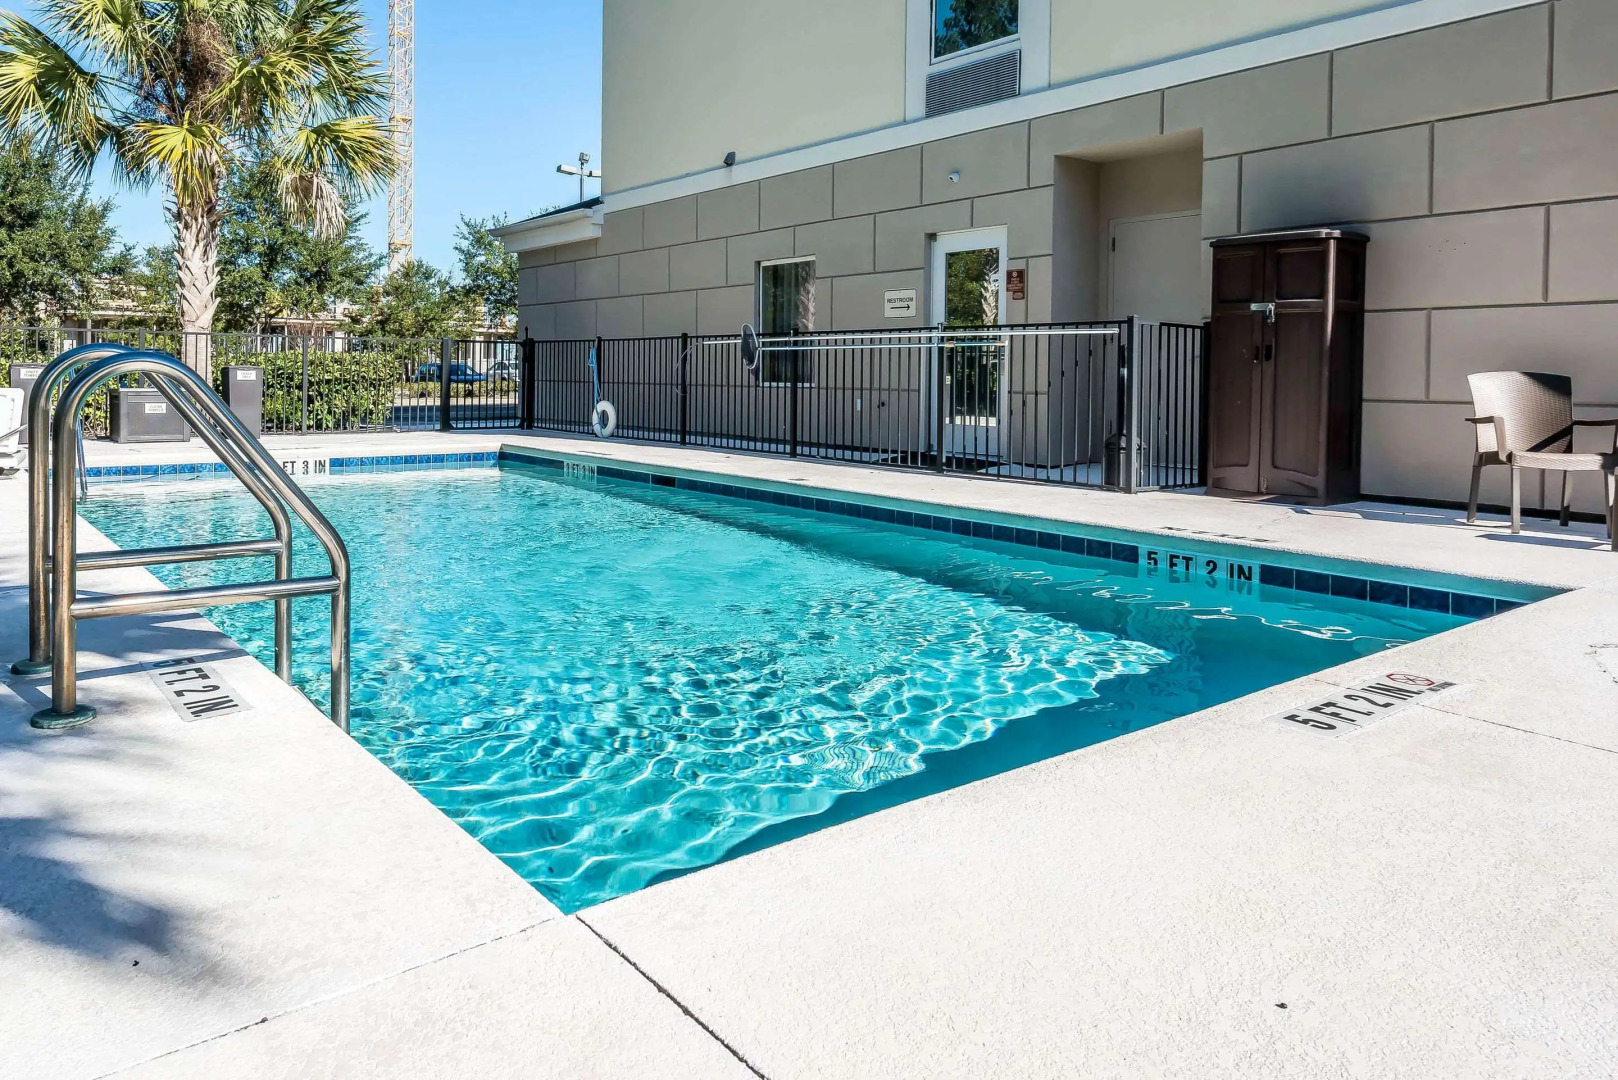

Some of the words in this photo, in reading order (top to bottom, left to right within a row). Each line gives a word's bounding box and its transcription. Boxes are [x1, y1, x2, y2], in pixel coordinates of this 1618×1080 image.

[886, 296, 914, 304] RESTROOM
[282, 461, 296, 470] FT
[314, 459, 326, 469] IN
[1147, 550, 1159, 567] 5
[1168, 553, 1194, 573] FT
[1205, 559, 1218, 575] 2
[1229, 562, 1253, 582] IN
[152, 657, 196, 668] 5
[173, 685, 221, 698] 2
[1283, 713, 1337, 731] 5
[1343, 693, 1395, 709] 2
